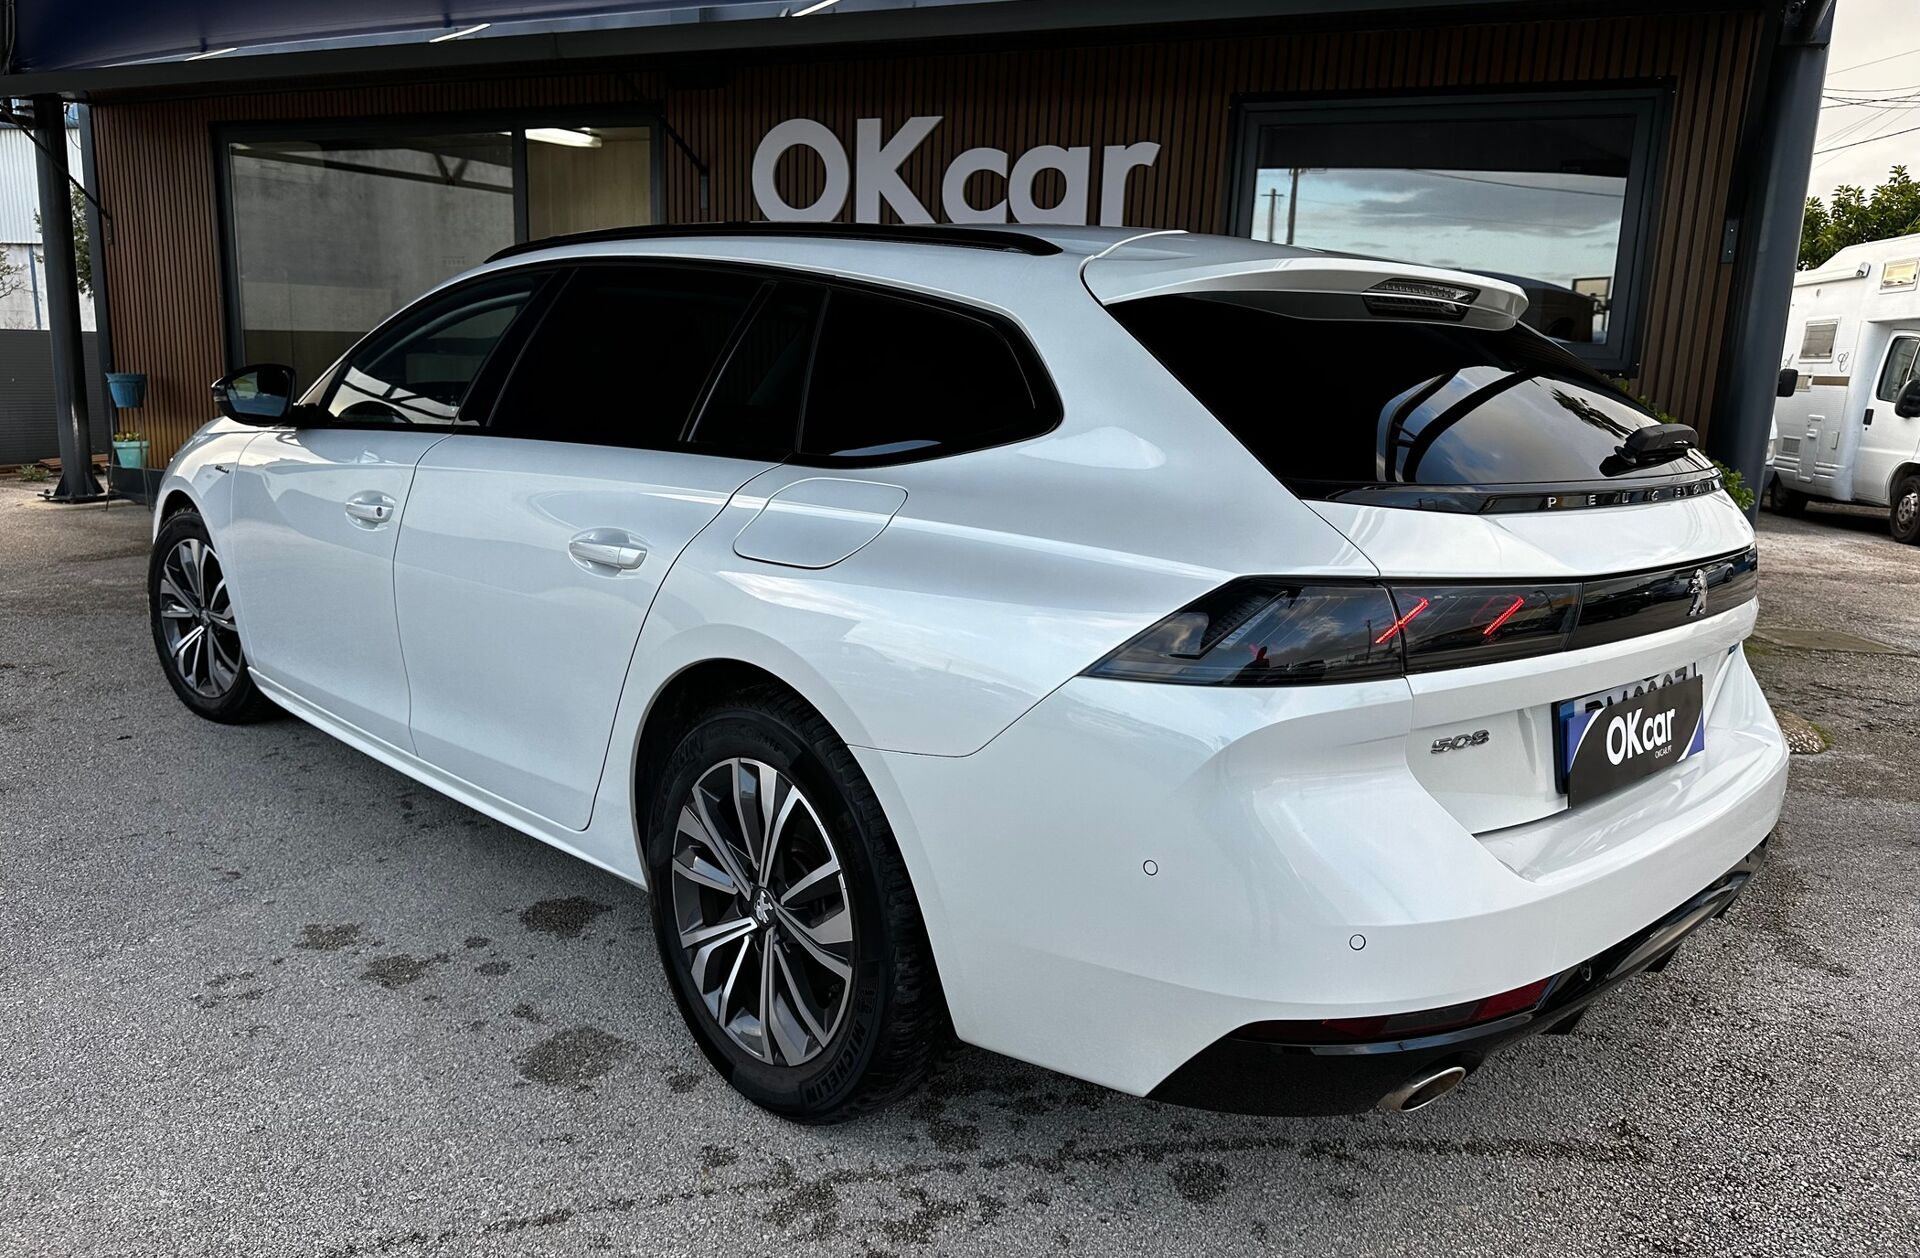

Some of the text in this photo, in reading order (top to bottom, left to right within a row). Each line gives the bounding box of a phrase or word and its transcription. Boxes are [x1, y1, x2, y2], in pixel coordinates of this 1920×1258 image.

[752, 115, 1161, 227] OKcar
[1430, 729, 1490, 754] 508
[1606, 708, 1676, 766] OKcar
[806, 1018, 866, 1105] MICHELIN
